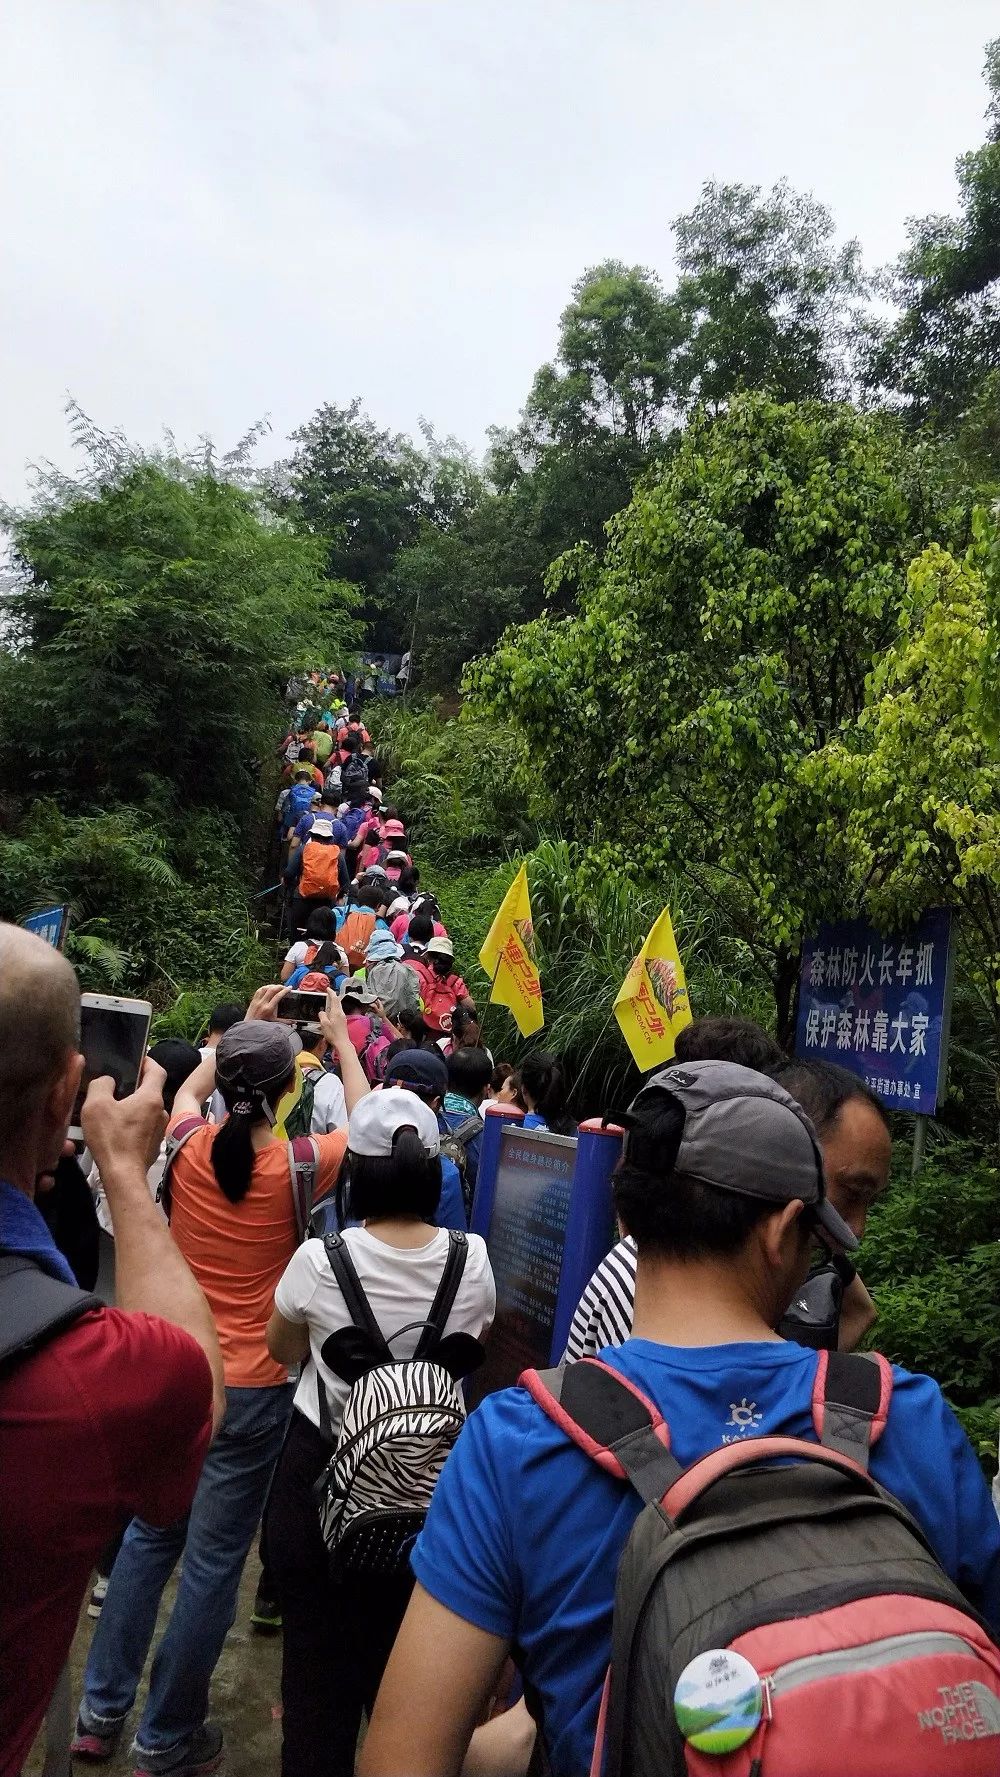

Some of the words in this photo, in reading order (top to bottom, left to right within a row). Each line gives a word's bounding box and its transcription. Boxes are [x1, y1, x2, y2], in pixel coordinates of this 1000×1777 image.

[810, 942, 934, 987] 森林防火长年抓
[805, 1009, 929, 1057] 保护森林靠大家
[937, 1682, 976, 1706] THE
[917, 1697, 978, 1730] NORTH
[942, 1718, 988, 1745] FACE
